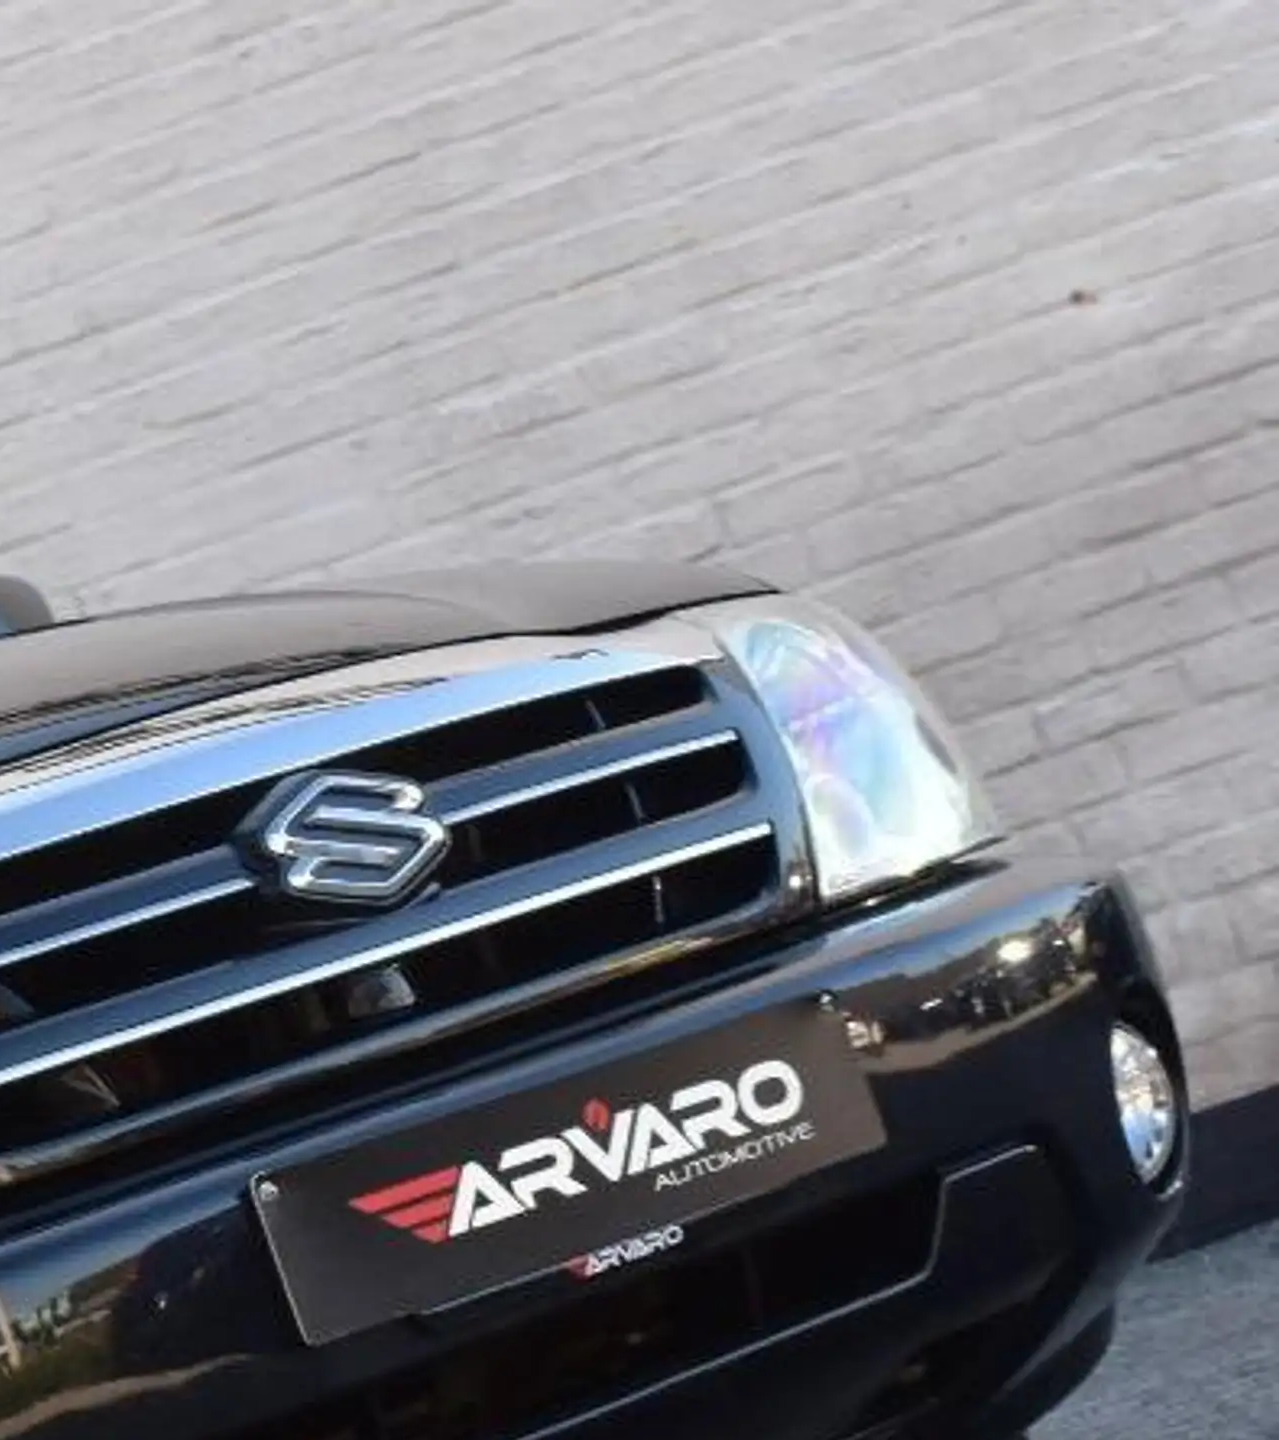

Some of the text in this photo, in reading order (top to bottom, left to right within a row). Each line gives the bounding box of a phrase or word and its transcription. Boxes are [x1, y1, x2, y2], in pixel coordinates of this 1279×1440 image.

[448, 1060, 802, 1237] ARVARO
[654, 1120, 816, 1191] AUTOMOTIVE
[584, 1225, 684, 1276] ARVARO
